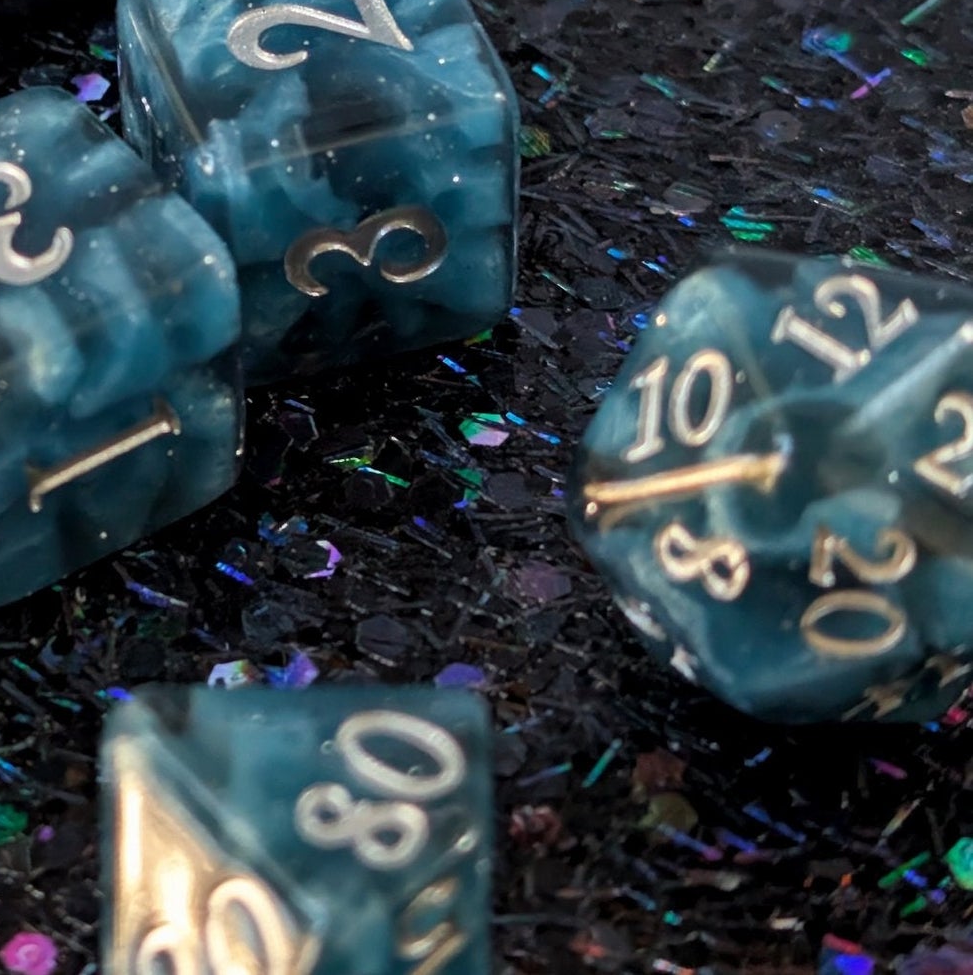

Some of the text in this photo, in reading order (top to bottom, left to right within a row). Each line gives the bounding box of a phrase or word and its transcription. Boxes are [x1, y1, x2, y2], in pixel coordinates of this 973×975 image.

[283, 207, 449, 298] 3
[769, 273, 921, 386] 12
[28, 395, 183, 514] 1
[619, 347, 734, 465] 10
[653, 520, 751, 603] 8
[799, 524, 921, 668] 20
[294, 708, 468, 872] 80
